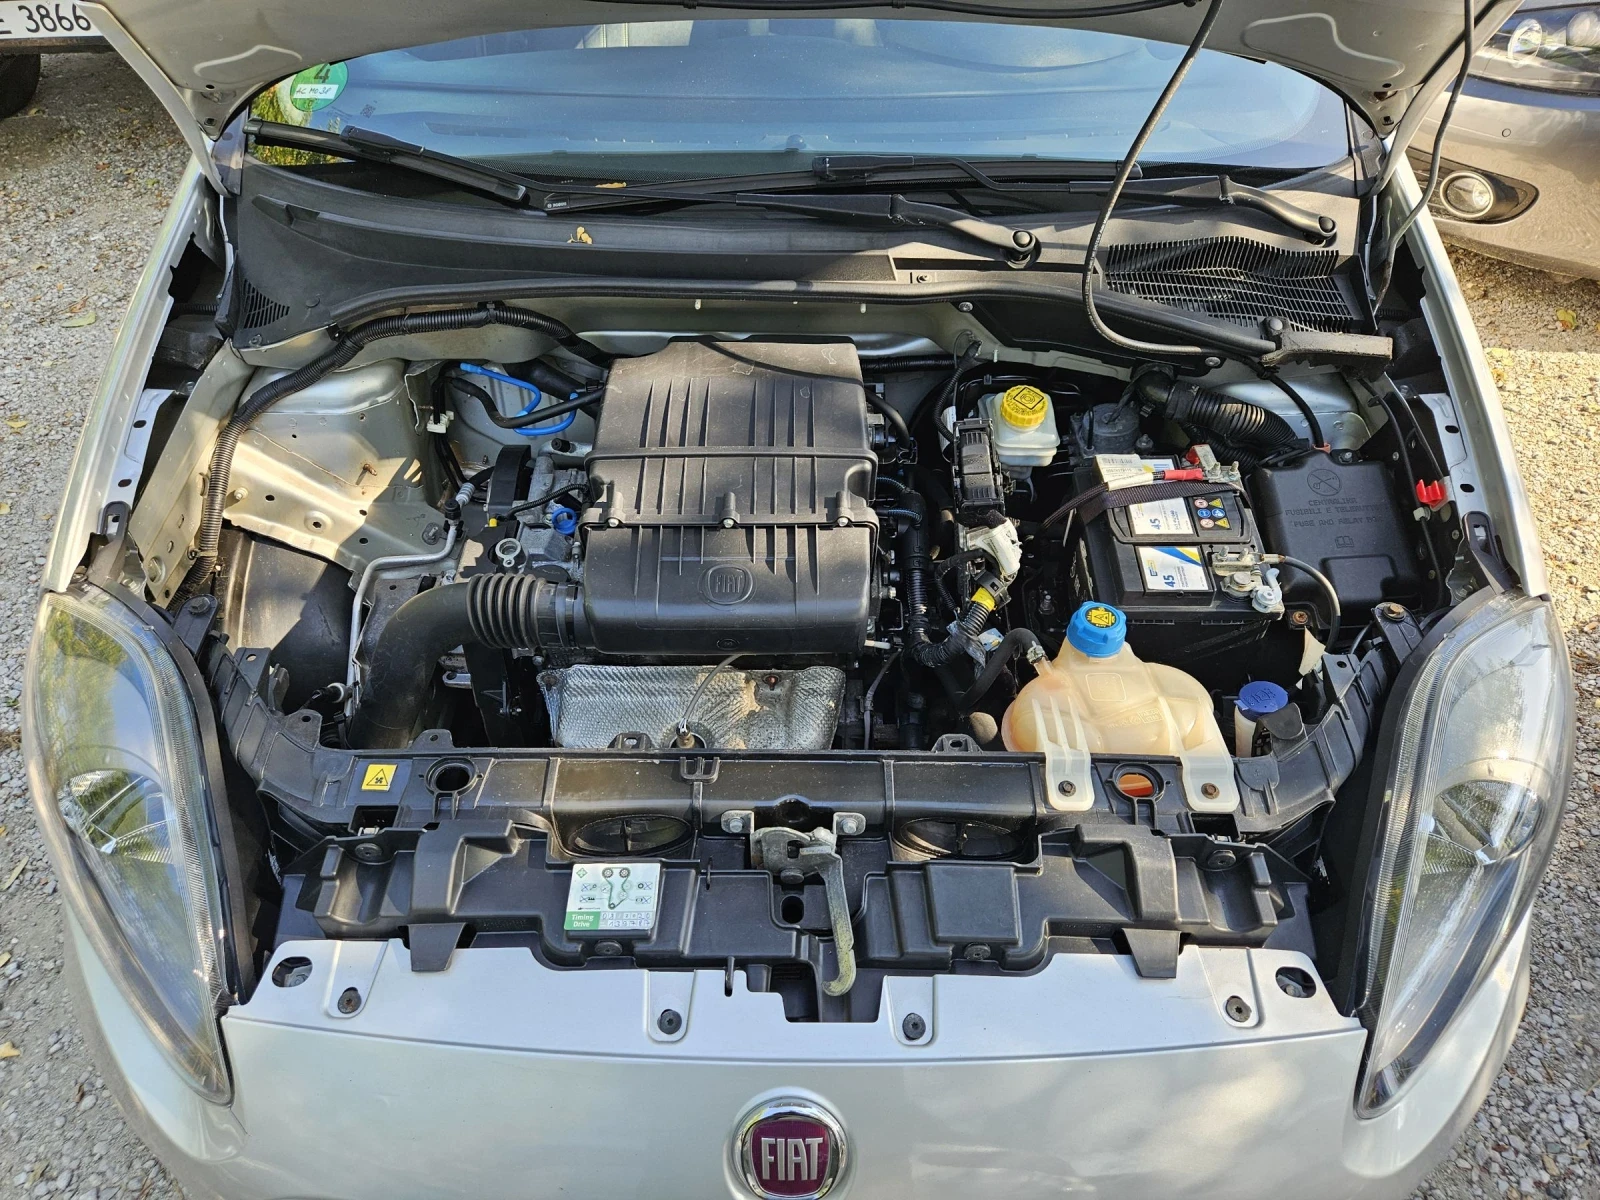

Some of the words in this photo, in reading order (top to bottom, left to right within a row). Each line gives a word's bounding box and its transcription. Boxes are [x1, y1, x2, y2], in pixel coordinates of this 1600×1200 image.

[18, 4, 91, 33] 3866
[314, 62, 330, 83] 4
[1149, 518, 1161, 530] 45
[715, 574, 743, 593] FIAT
[1163, 574, 1176, 588] 45
[761, 1137, 824, 1181] FIAT
